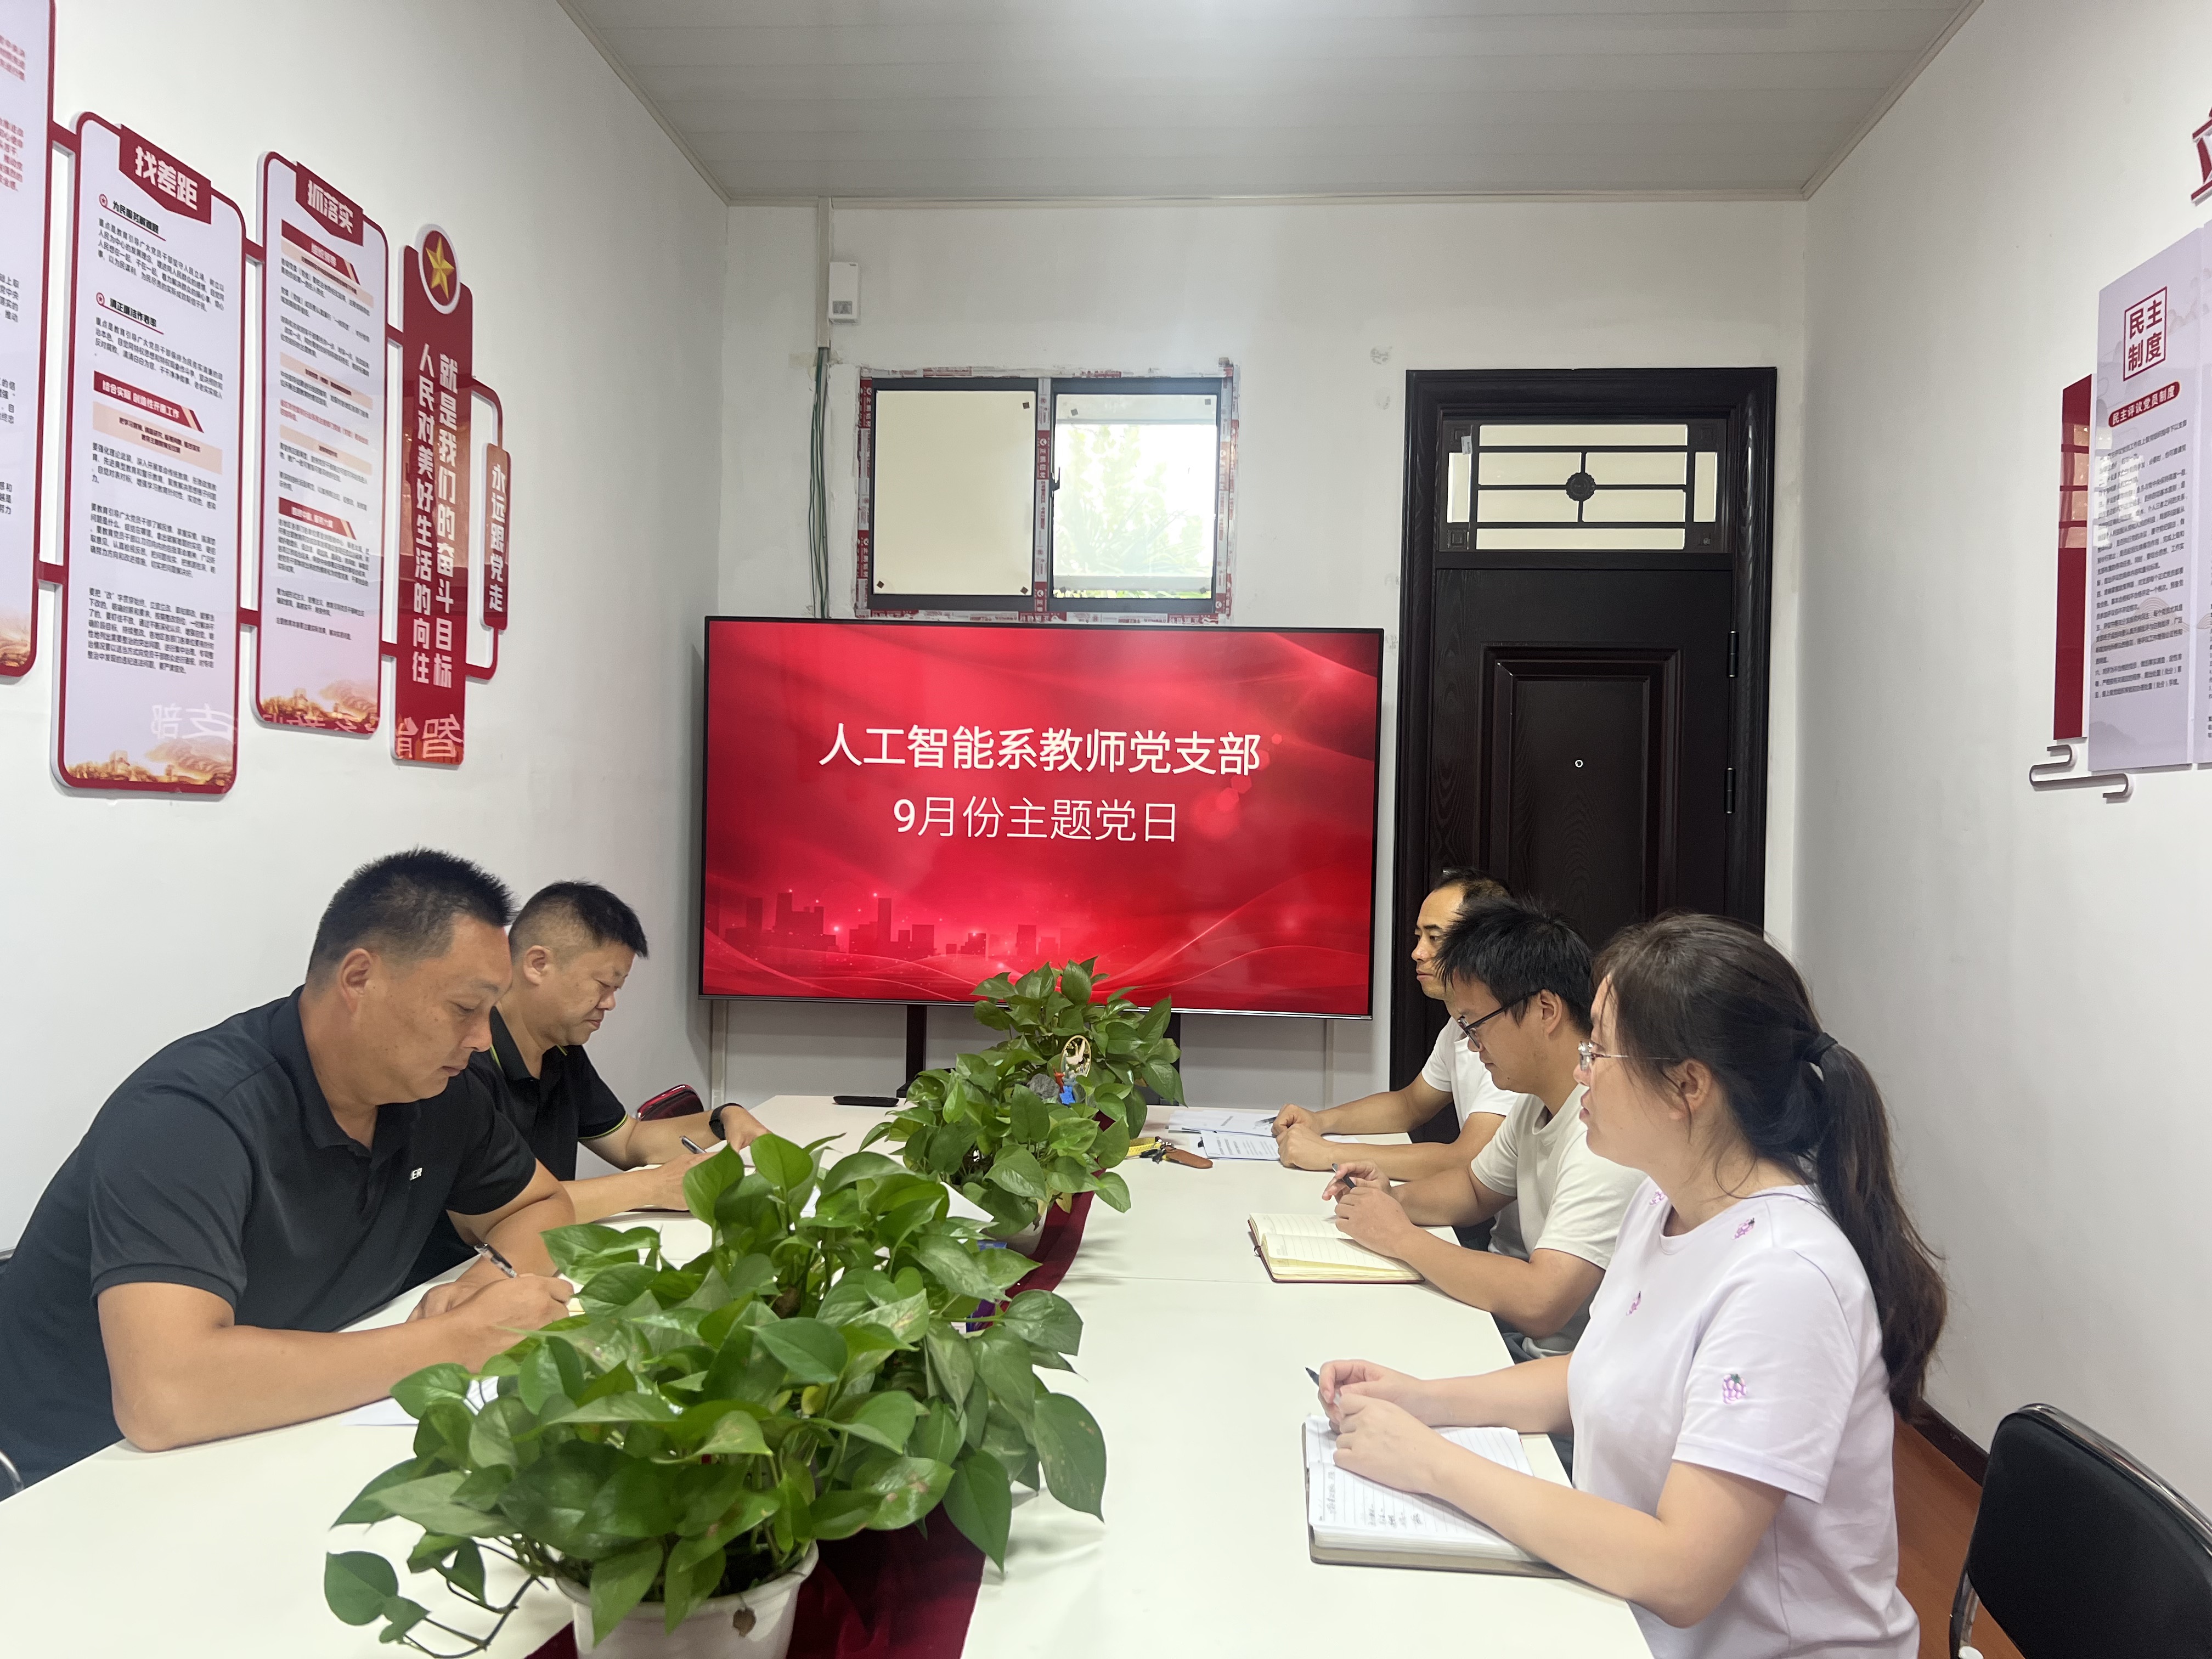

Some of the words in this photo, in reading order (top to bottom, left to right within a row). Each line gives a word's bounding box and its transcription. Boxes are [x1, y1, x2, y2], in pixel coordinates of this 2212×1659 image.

[135, 145, 198, 211] 找差距
[308, 179, 354, 234] 抓落实
[2129, 299, 2163, 340] 民主
[2128, 331, 2163, 373] 制度
[102, 380, 132, 400] 结合实际
[133, 392, 180, 420] 创造性开展工作
[2112, 385, 2175, 425] 民主评议党员制度
[412, 342, 436, 684] 人民对美好生活的向往
[433, 353, 459, 689] 就是我们的奋斗目标
[489, 463, 507, 612] 永远跟党走
[819, 721, 1261, 776] 人工智能系教师党支部
[893, 795, 1176, 843] 9月份主题党日
